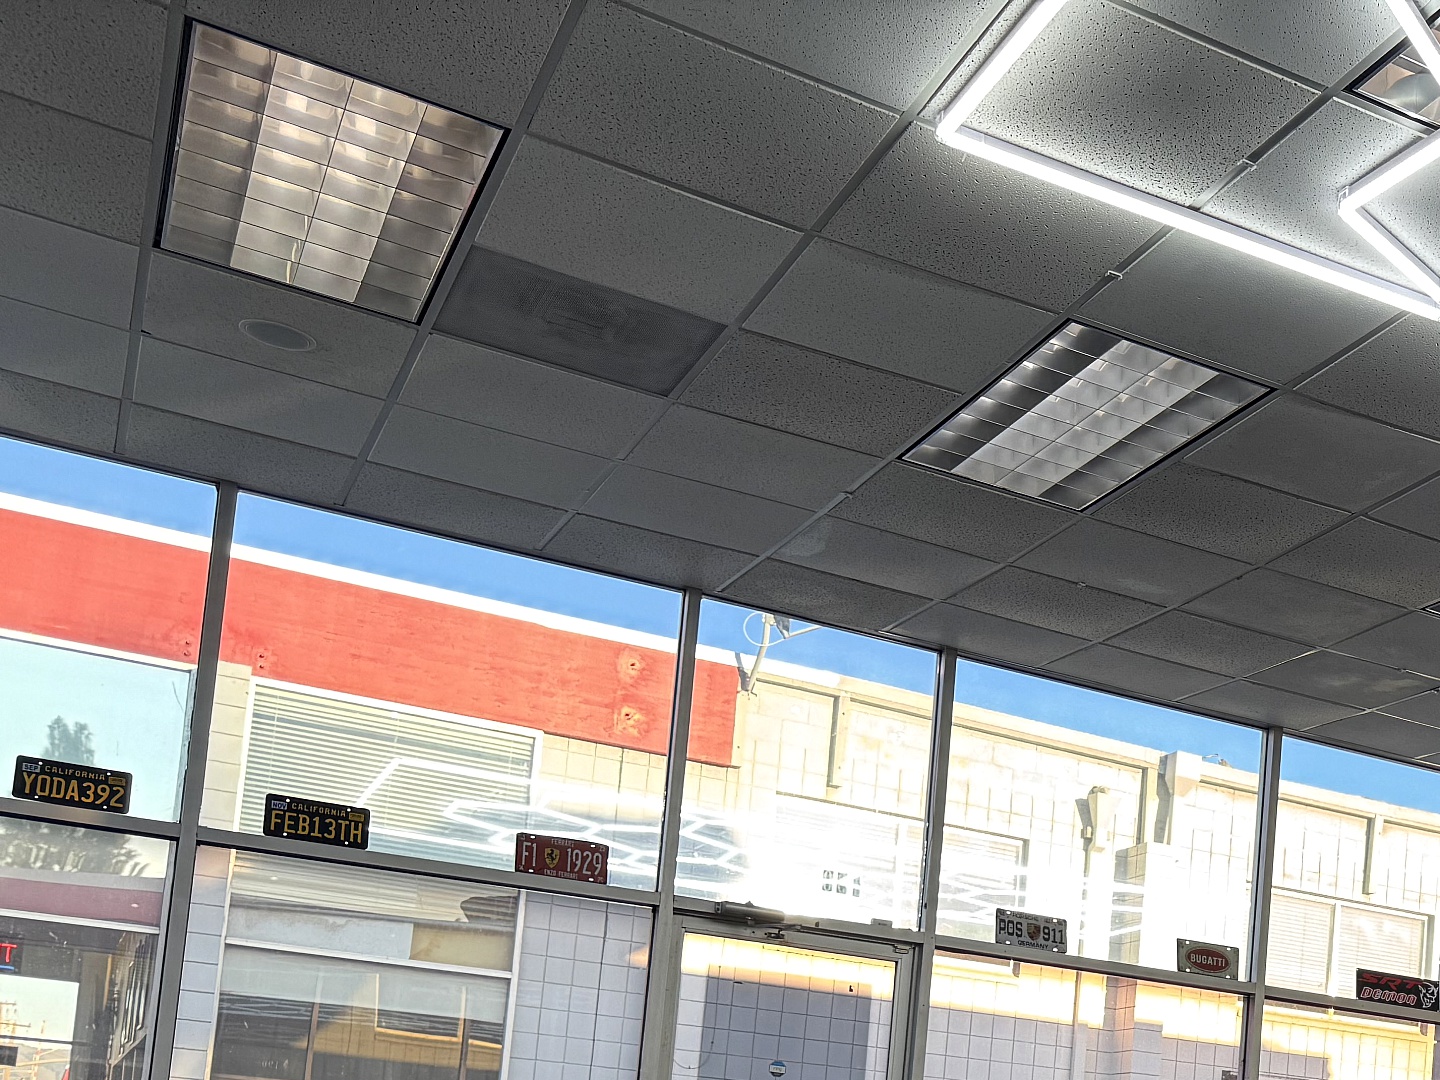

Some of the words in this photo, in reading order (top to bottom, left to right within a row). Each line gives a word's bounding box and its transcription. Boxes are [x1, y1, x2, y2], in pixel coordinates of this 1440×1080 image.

[45, 765, 105, 781] CALIFORNIA
[22, 772, 125, 808] YODA392
[272, 801, 287, 810] NOV
[291, 803, 346, 817] CALIFORNIA
[270, 810, 363, 844] FEB13TH
[522, 842, 537, 867] F1
[566, 848, 603, 876] 1929
[1017, 939, 1049, 949] GERMANY
[1042, 926, 1065, 945] 911
[1190, 953, 1225, 967] BUGATTI
[1359, 972, 1424, 990] SRT
